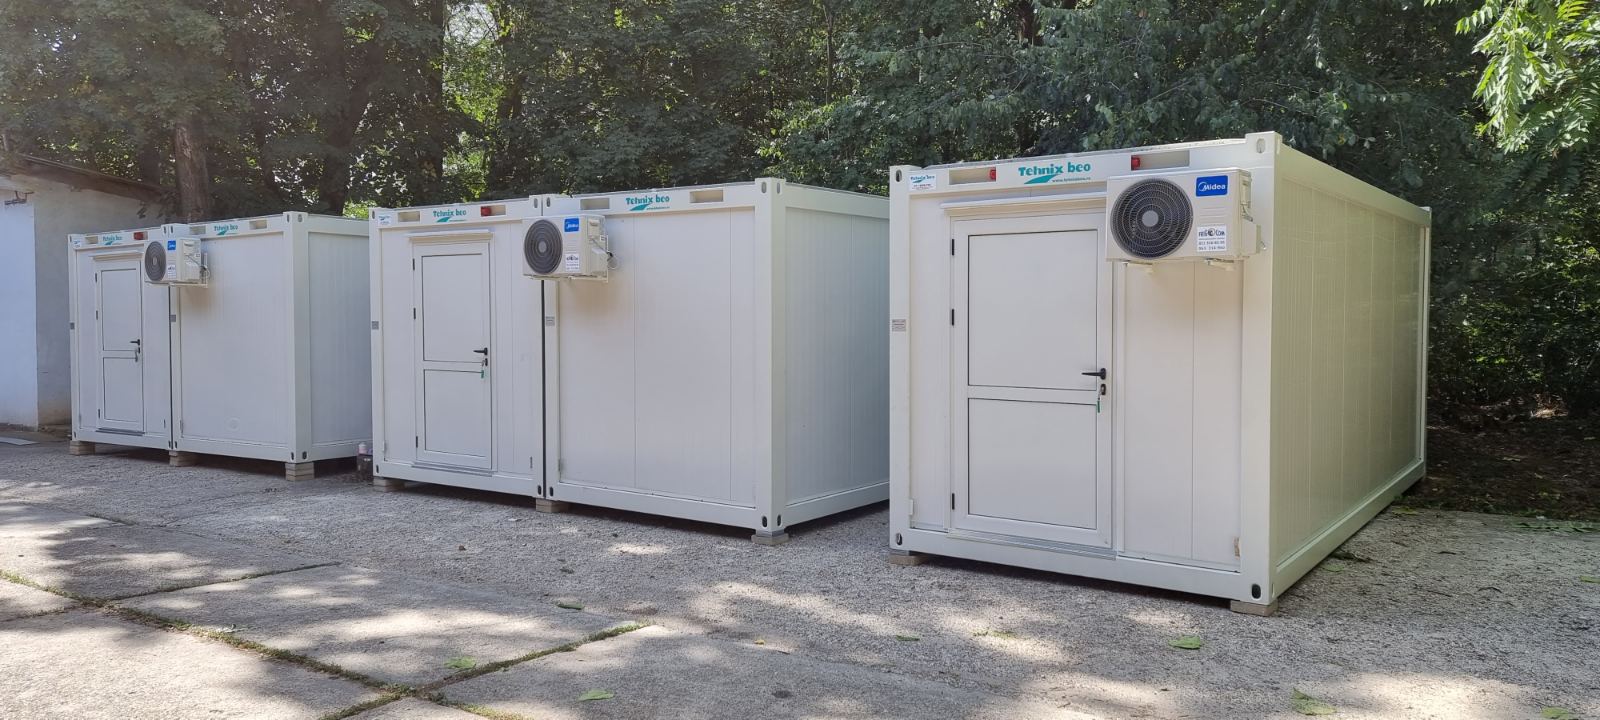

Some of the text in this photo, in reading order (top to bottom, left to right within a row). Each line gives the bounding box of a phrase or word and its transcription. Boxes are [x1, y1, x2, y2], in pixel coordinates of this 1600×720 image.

[1018, 162, 1091, 176] Tehnix beo
[1201, 183, 1227, 192] Midea
[625, 194, 670, 205] Tehnix beo
